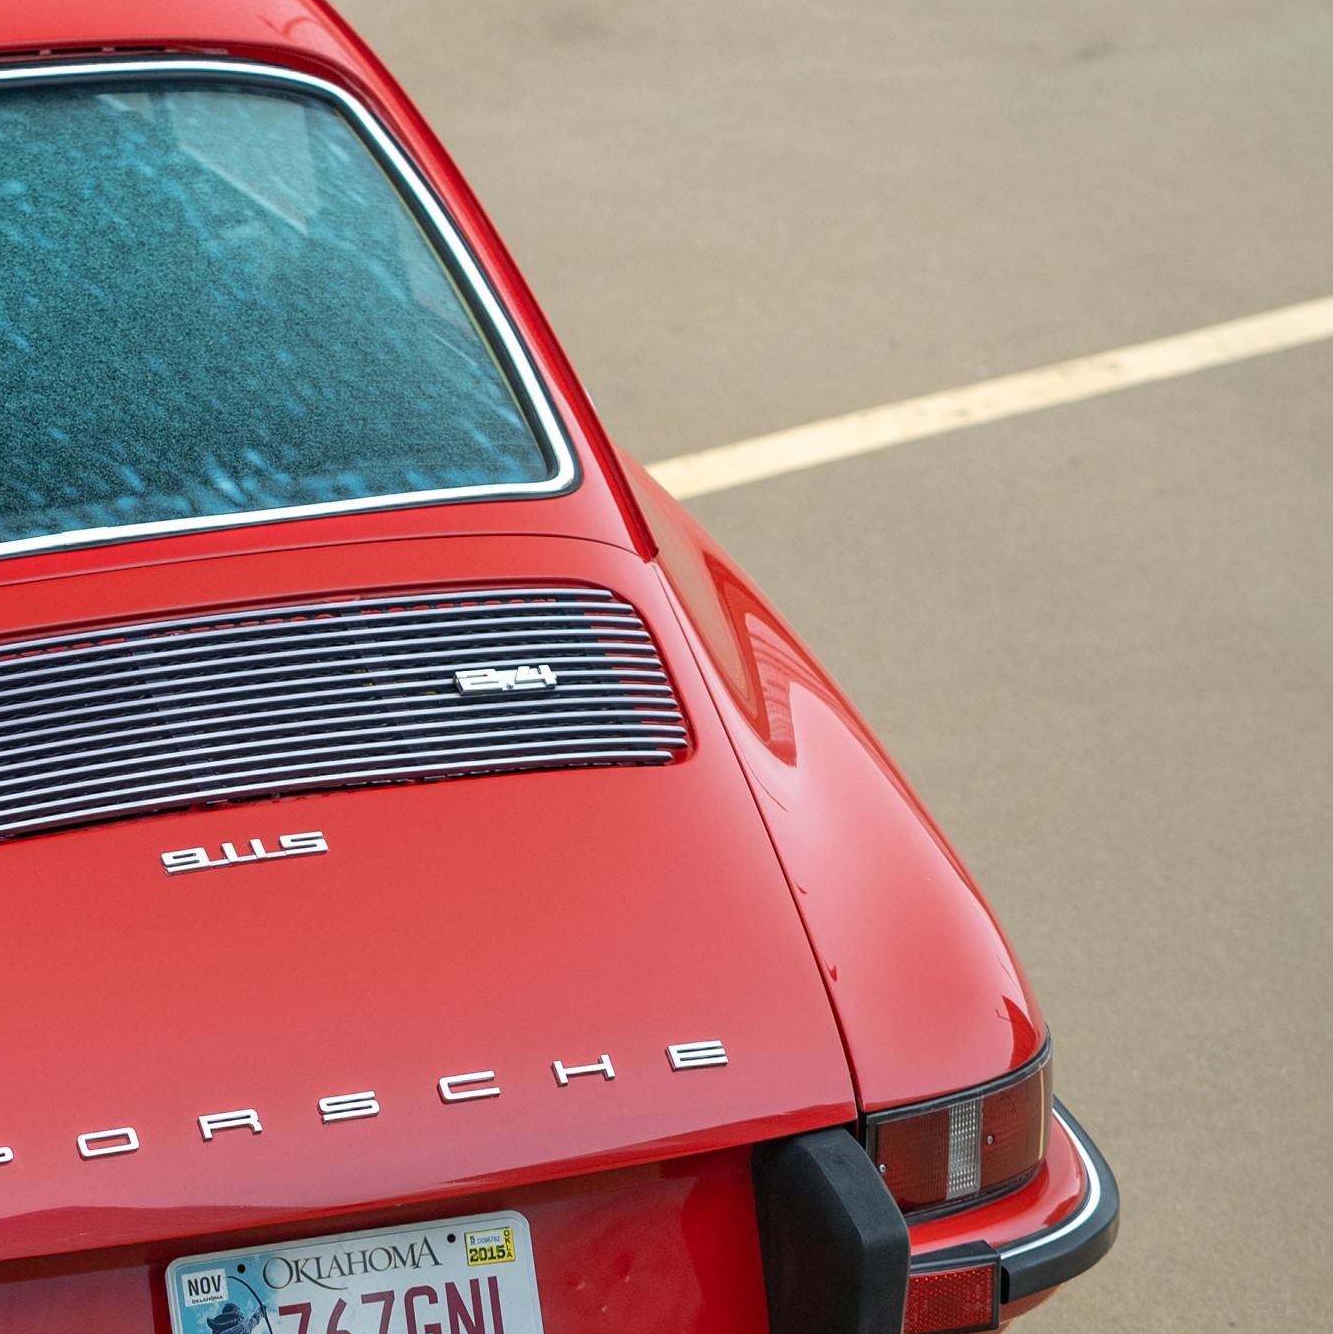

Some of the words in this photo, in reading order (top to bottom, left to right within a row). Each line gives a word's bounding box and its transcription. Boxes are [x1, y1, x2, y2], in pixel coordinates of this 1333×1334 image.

[453, 664, 557, 696] 2.4
[160, 831, 328, 875] 911S
[469, 1244, 506, 1262] 2015
[504, 1230, 513, 1258] OKLA
[262, 1236, 443, 1290] OKLAHOMA
[187, 1274, 221, 1296] NOV
[191, 1295, 223, 1304] OKLAHOMA
